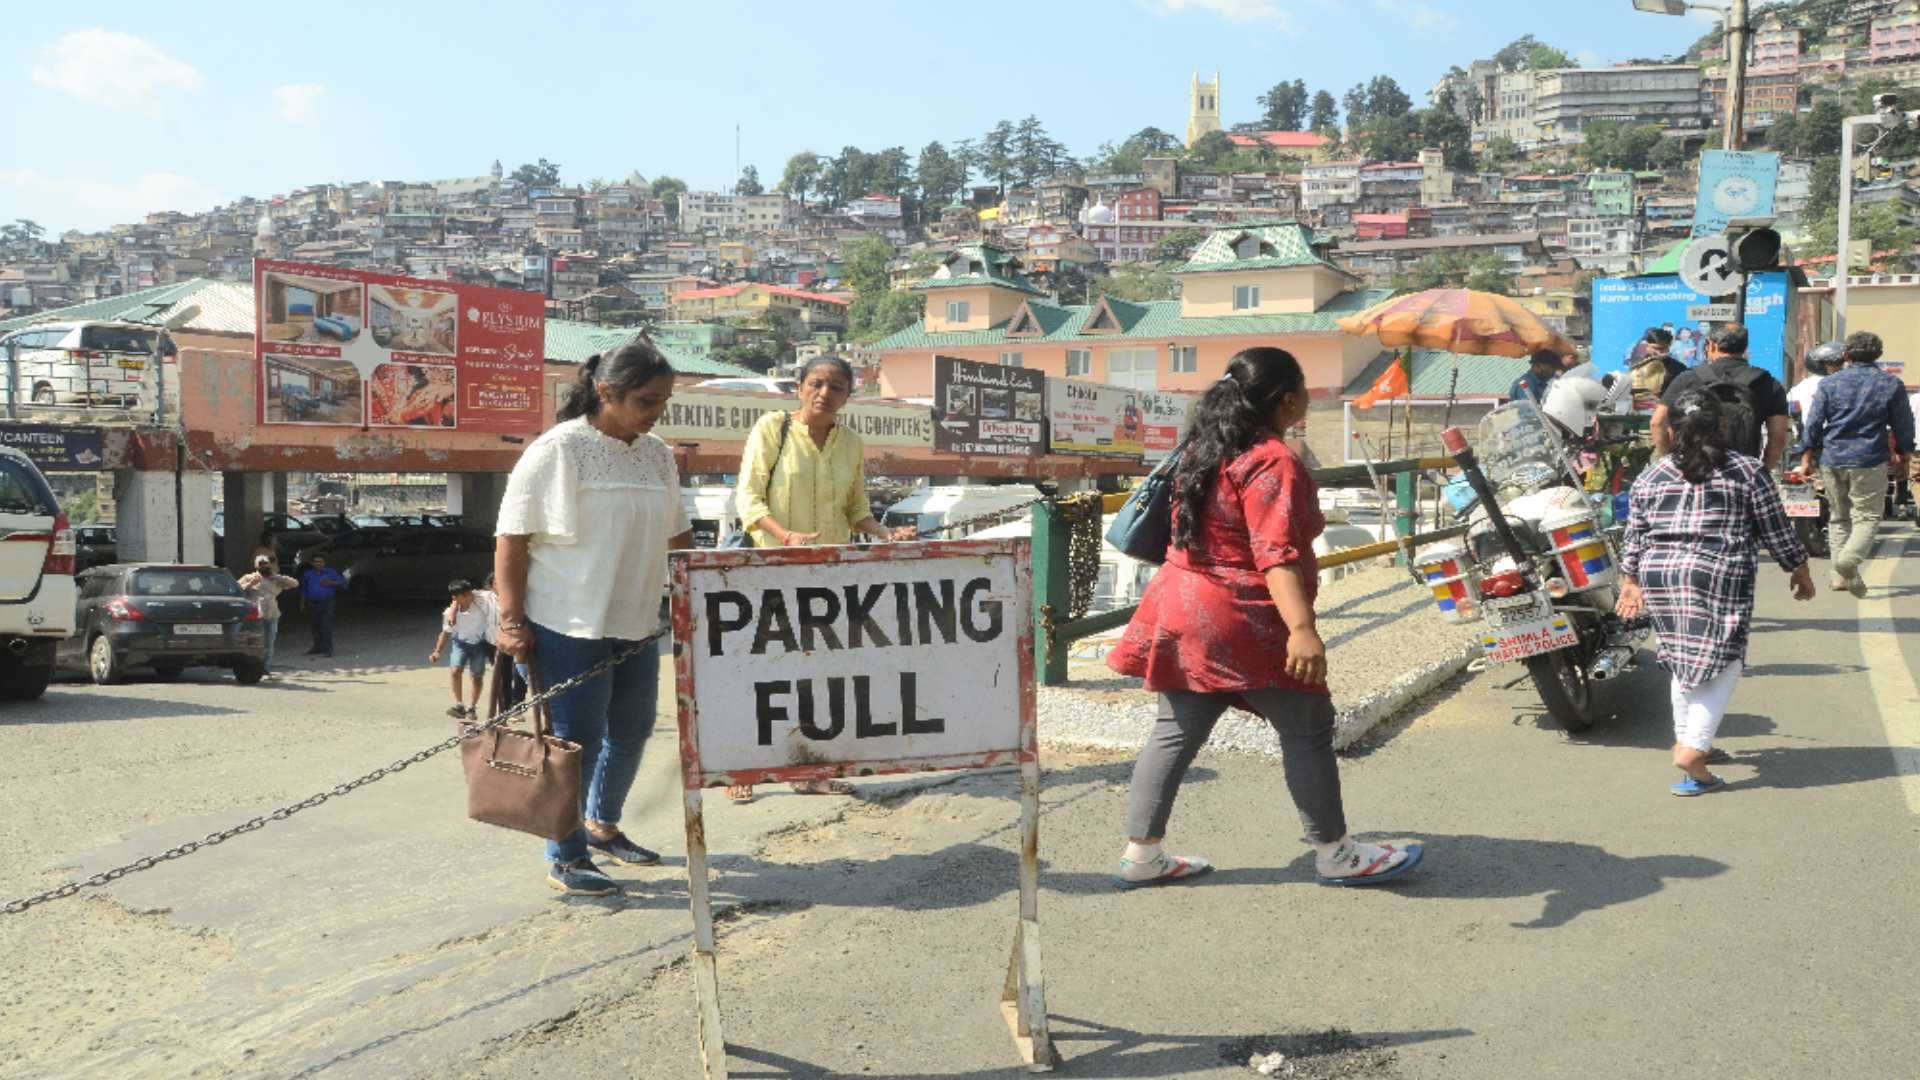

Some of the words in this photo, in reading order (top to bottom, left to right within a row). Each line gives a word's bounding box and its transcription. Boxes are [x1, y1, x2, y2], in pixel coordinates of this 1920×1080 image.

[660, 403, 726, 429] ARKING
[704, 577, 1003, 657] PARKING
[1487, 644, 1534, 661] TRAFFIC
[1535, 633, 1576, 651] POLICE
[1498, 626, 1549, 648] SHIMLA
[754, 671, 945, 746] FULL
